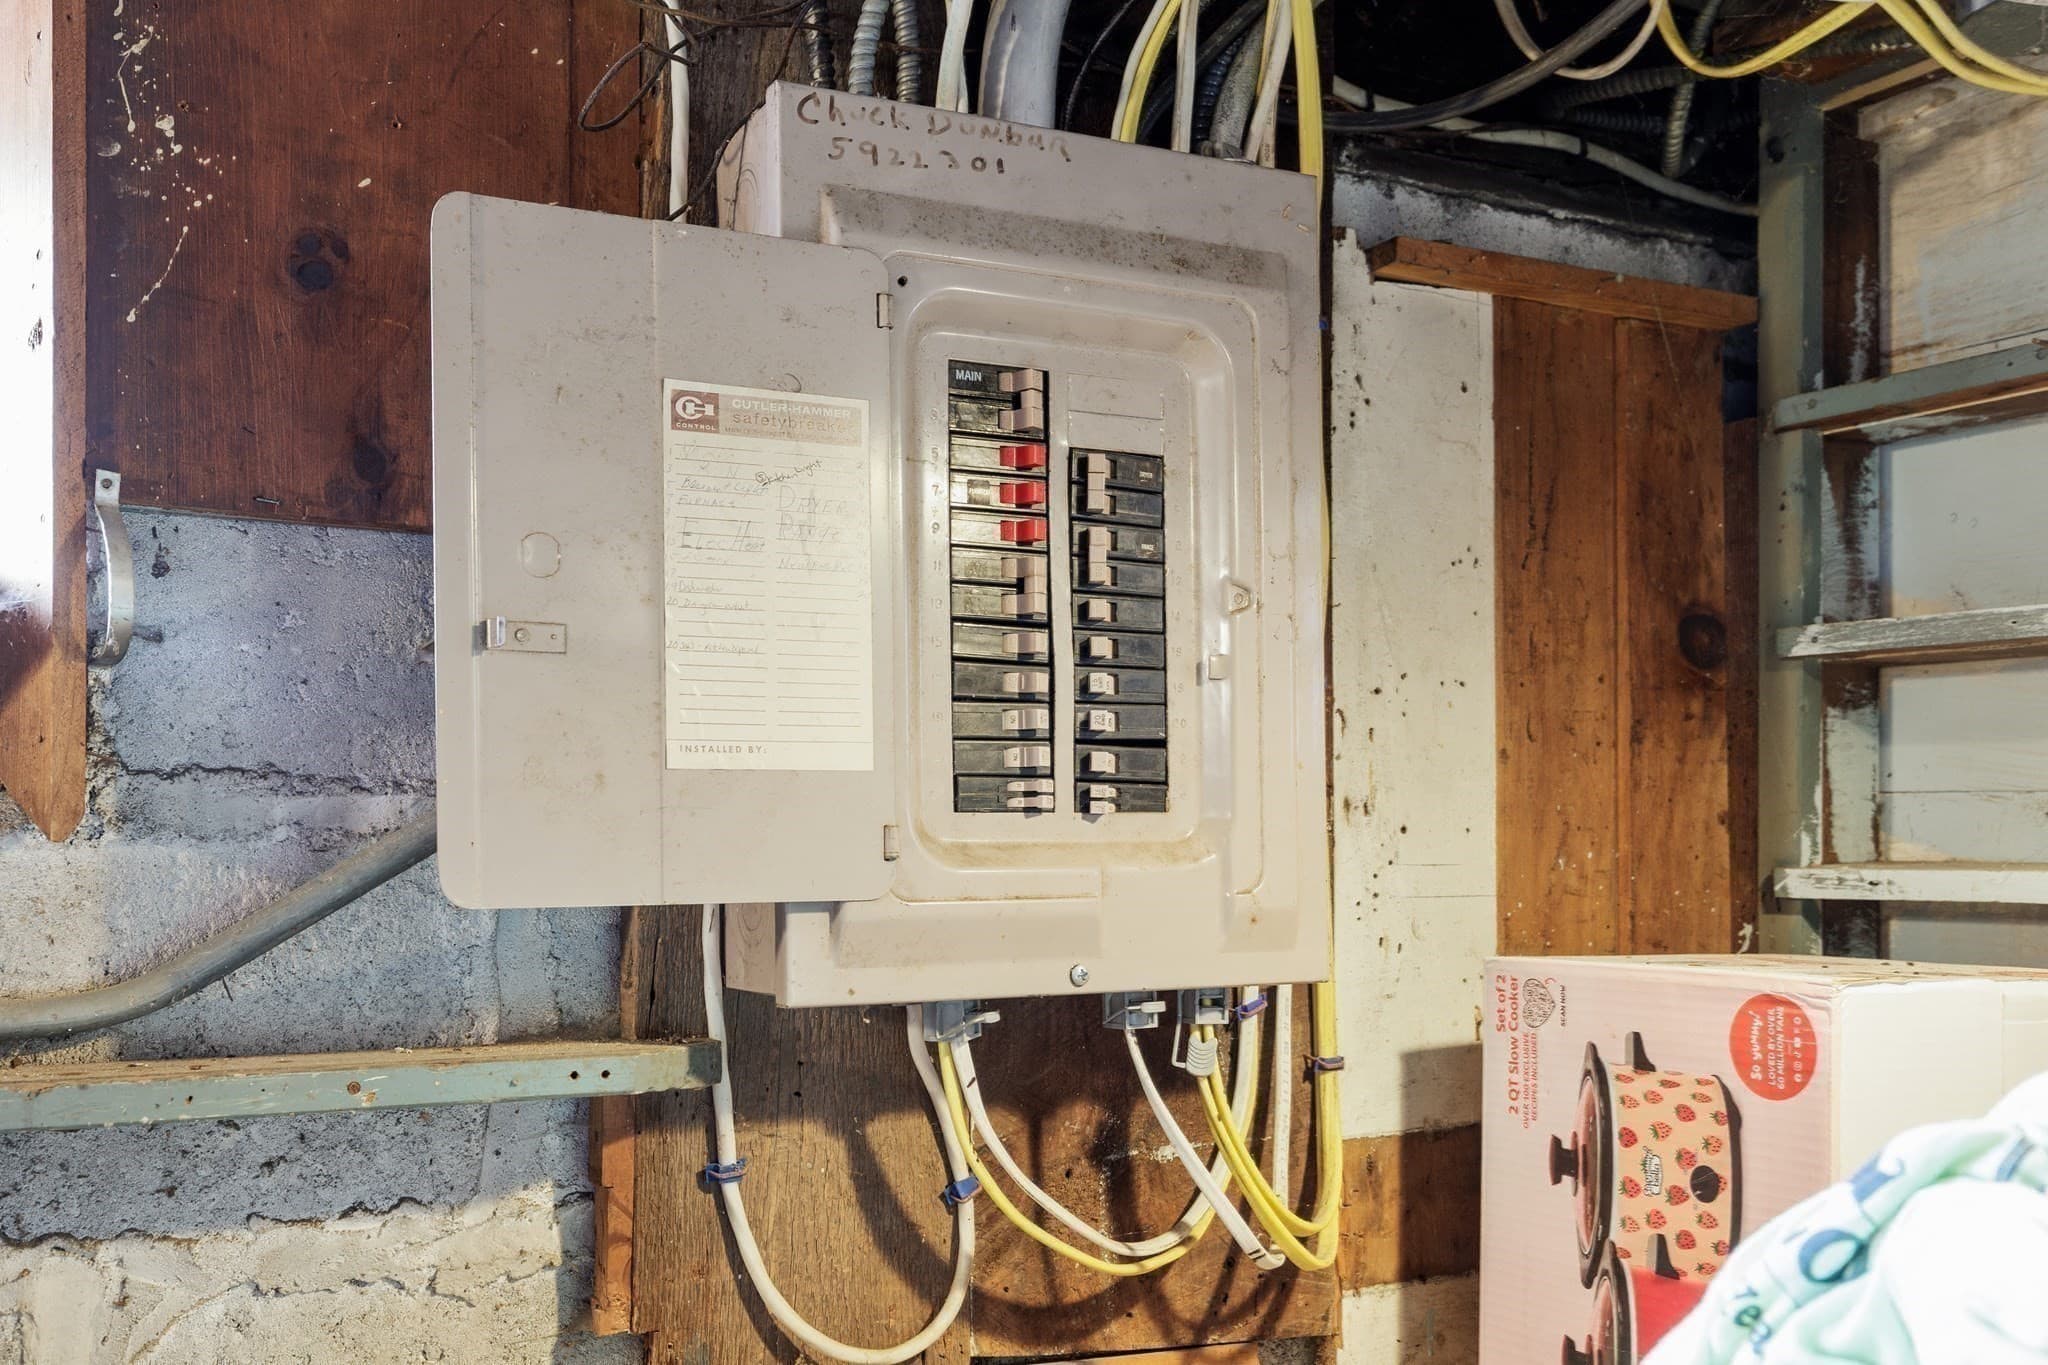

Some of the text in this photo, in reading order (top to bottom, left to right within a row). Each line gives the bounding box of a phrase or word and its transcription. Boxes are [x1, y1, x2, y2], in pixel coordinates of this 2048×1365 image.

[955, 369, 982, 382] MAIN
[676, 422, 717, 431] CONTROL
[679, 744, 768, 755] INSTALLED BY:
[1496, 974, 1506, 1033] Set of 2
[1776, 1006, 1785, 1032] FANS
[1508, 976, 1520, 1115] 2 QT Slow Cooker
[1767, 1008, 1776, 1086] LOVED BY OVER
[1776, 1033, 1785, 1075] MILLION
[1750, 1064, 1762, 1080] So
